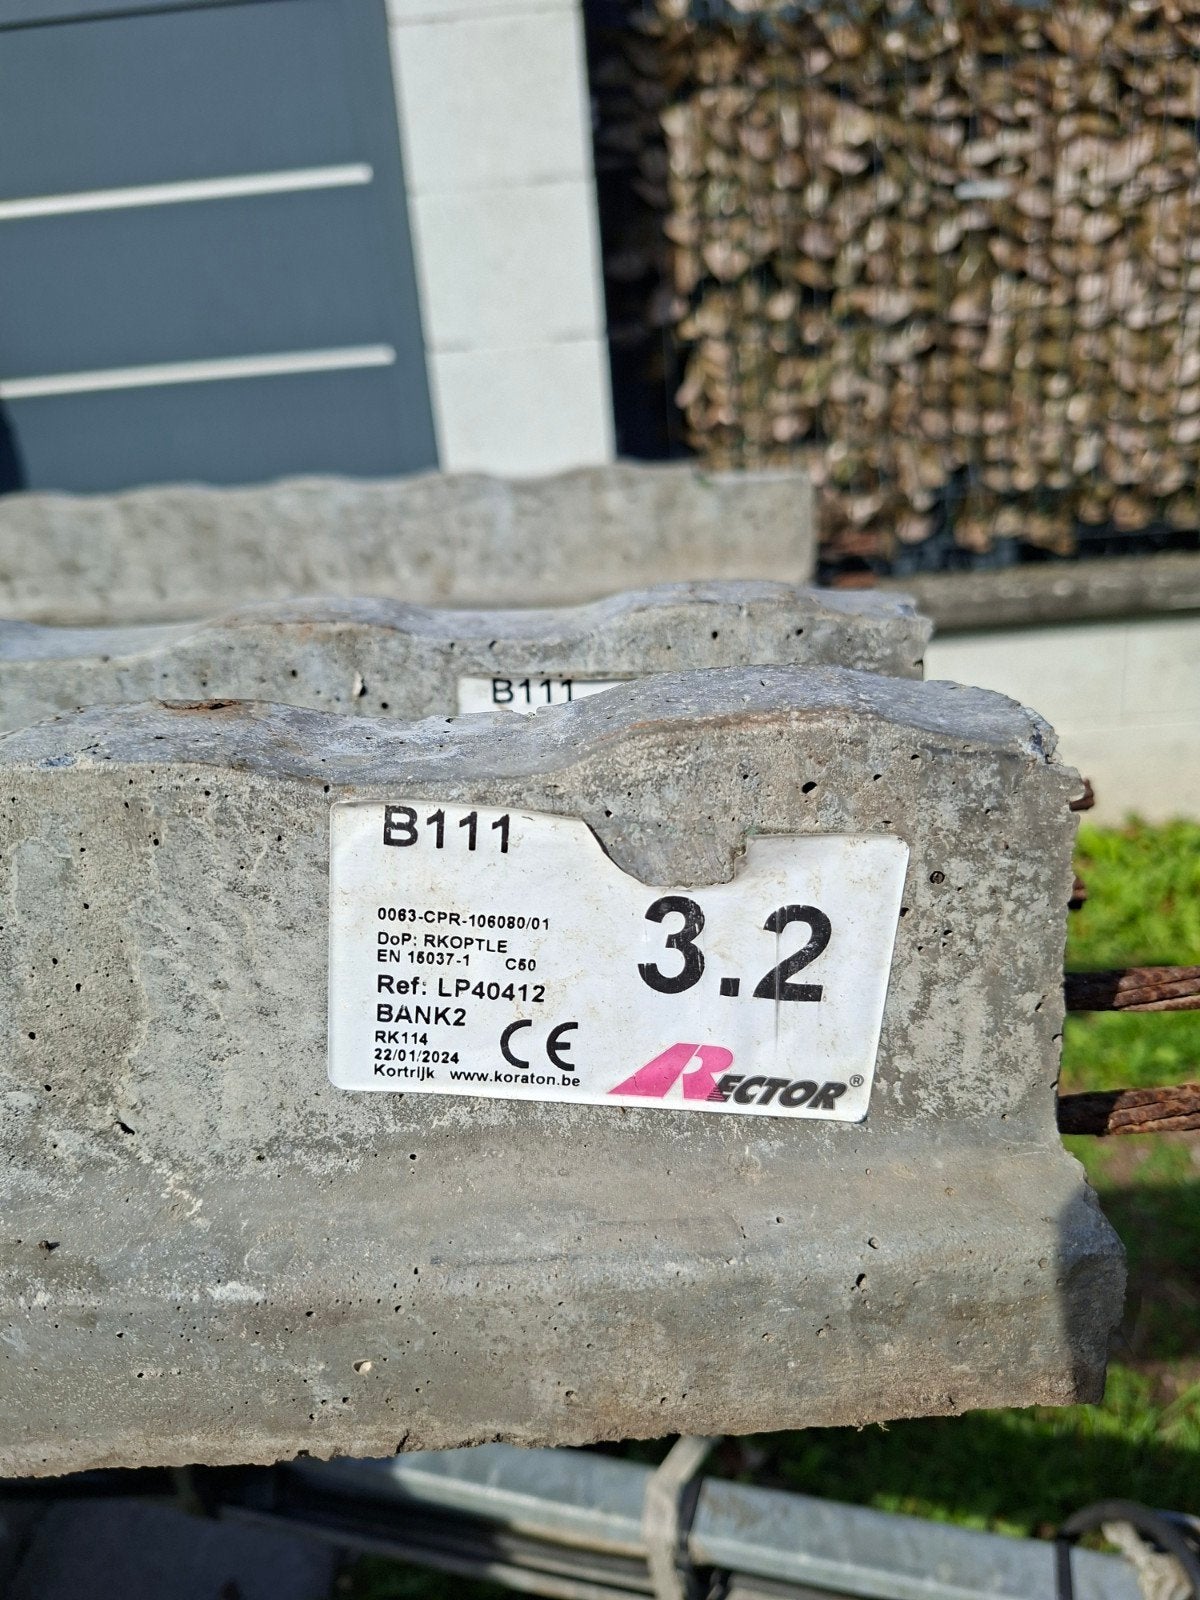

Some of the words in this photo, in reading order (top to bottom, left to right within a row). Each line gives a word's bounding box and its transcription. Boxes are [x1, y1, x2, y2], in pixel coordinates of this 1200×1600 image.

[492, 678, 572, 704] B111
[383, 805, 510, 853] B111
[377, 908, 550, 931] 0063-CPR-106080/01
[377, 932, 417, 947] DoP:
[424, 934, 508, 953] RKOPTLE
[638, 895, 832, 1002] 3.2
[377, 950, 401, 963] EN
[408, 952, 470, 967] 15037-1
[505, 958, 536, 971] C50
[377, 974, 427, 996] Ref:
[438, 977, 546, 1003] LP40412
[376, 1003, 466, 1027] BANK2
[374, 1031, 428, 1046] RK114
[374, 1048, 459, 1065] 22/01/2024
[374, 1064, 435, 1080] Kortrijk
[450, 1070, 581, 1087] www.koraton.be
